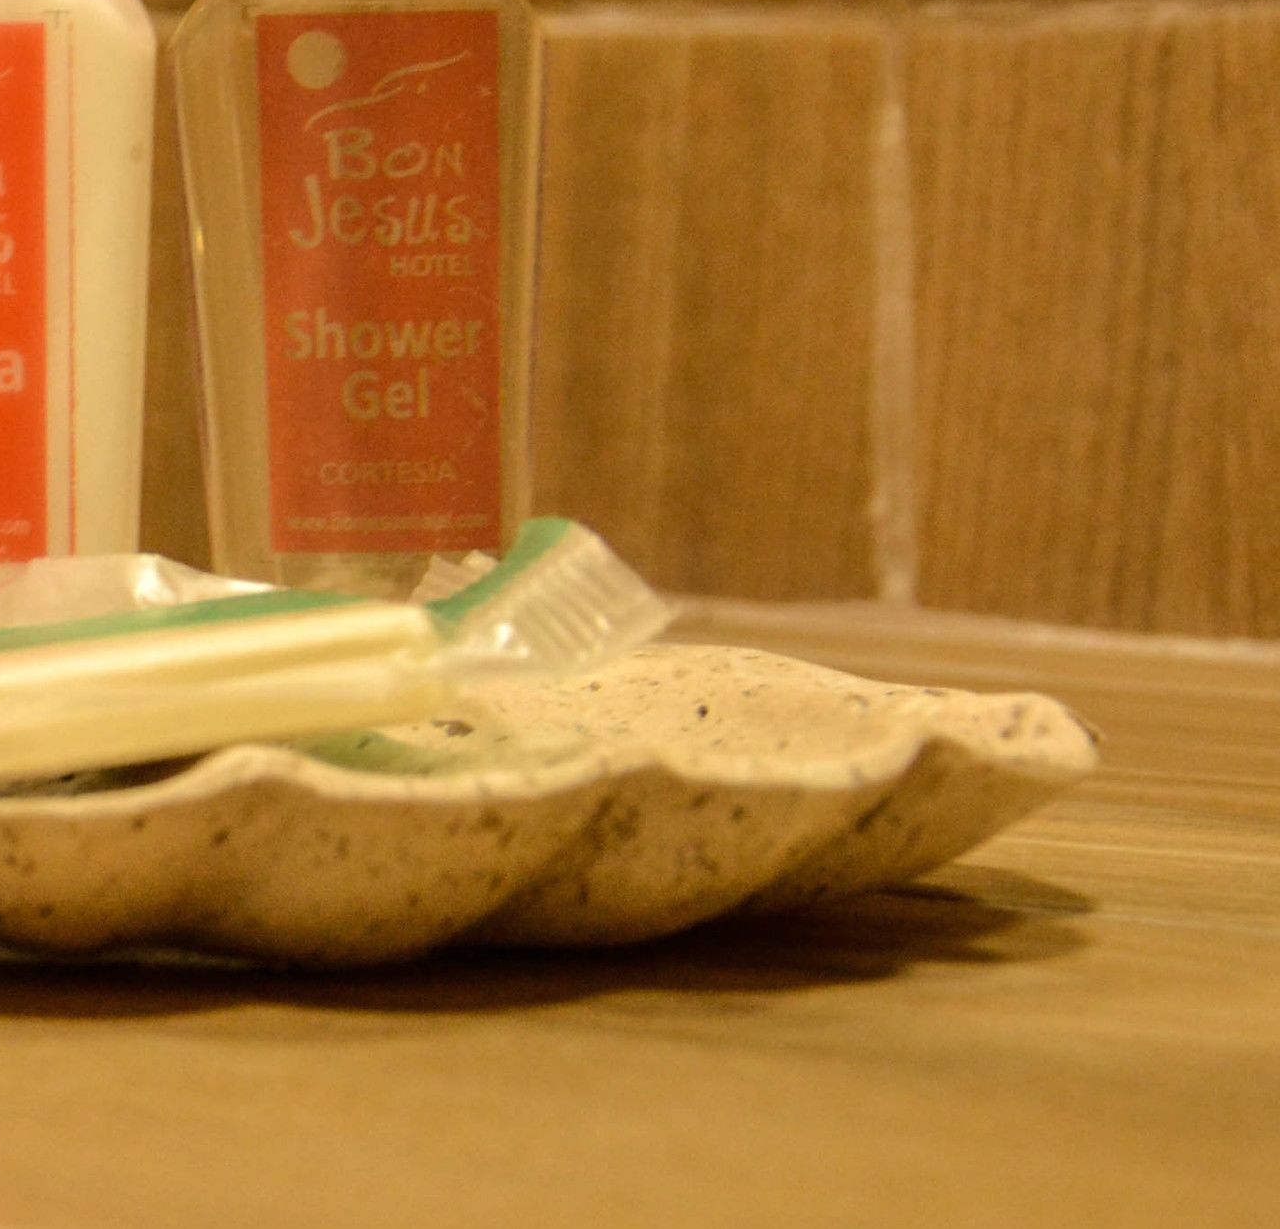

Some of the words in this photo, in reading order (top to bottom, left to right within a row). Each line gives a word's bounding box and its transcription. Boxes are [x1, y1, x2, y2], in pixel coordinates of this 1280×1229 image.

[390, 253, 476, 277] HOTEL
[283, 307, 484, 361] Shower
[341, 367, 431, 421] Gel
[318, 455, 458, 486] CORTESÍA
